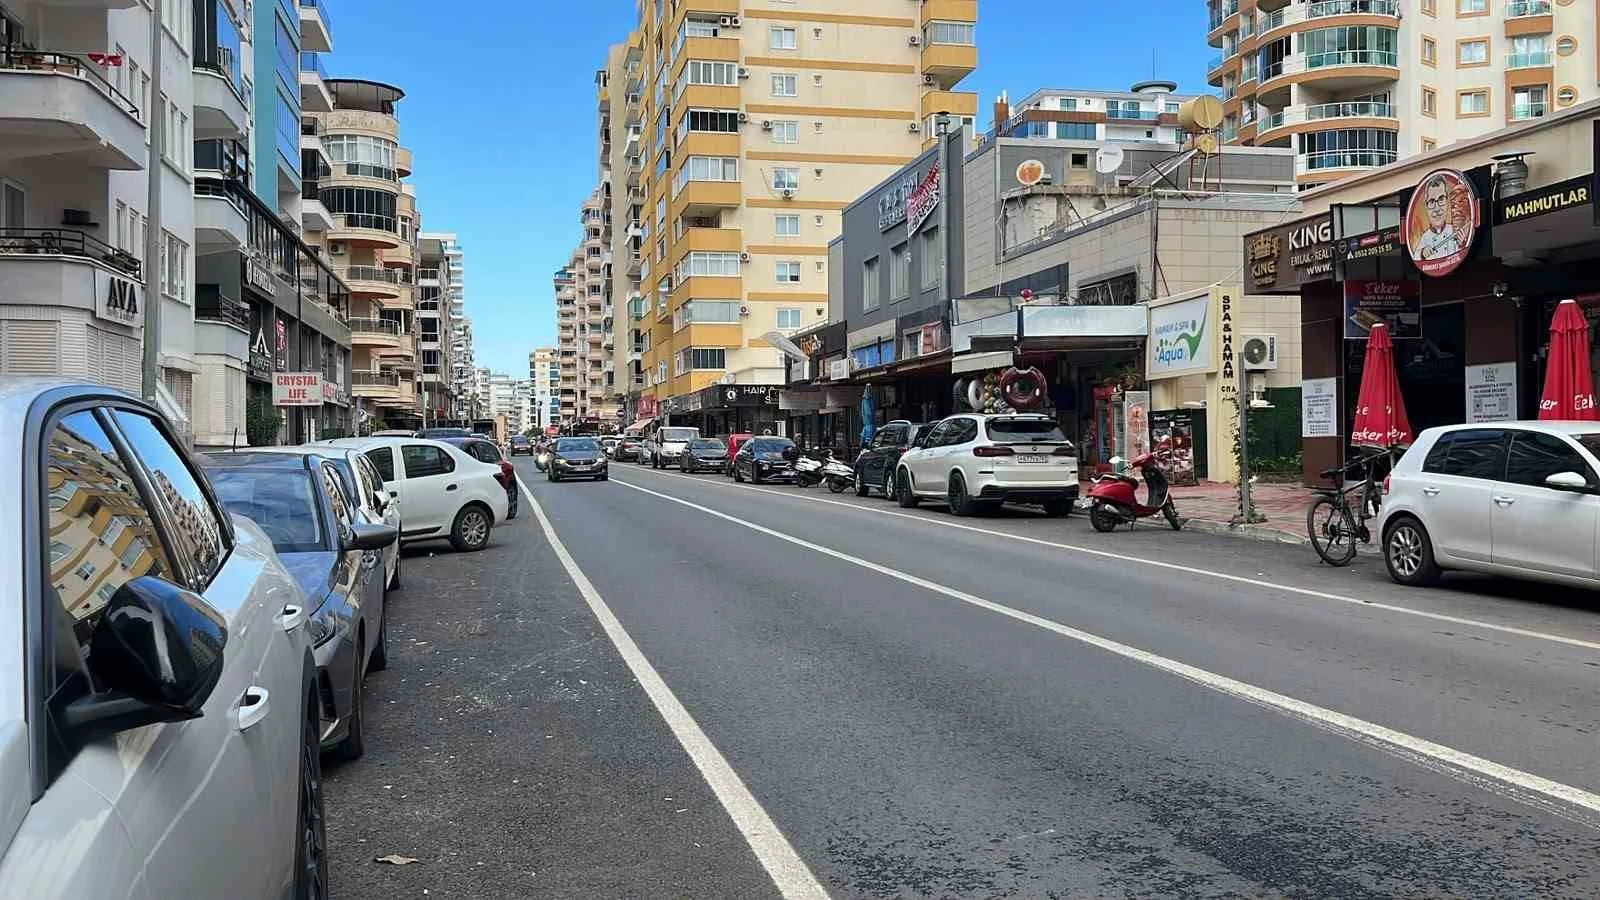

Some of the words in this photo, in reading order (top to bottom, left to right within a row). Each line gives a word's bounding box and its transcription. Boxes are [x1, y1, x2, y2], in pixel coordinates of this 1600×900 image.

[1505, 188, 1587, 219] MAHMUTLAR
[1289, 221, 1331, 251] KING
[1306, 264, 1333, 276] www.
[107, 276, 138, 313] AVA
[1222, 295, 1231, 321] SPA
[1223, 324, 1232, 332] &
[1159, 348, 1184, 367] Aqua
[1223, 335, 1233, 379] HAMAM
[277, 375, 318, 386] CRYSTAL
[288, 389, 307, 399] LIFE
[743, 386, 766, 395] HAIR
